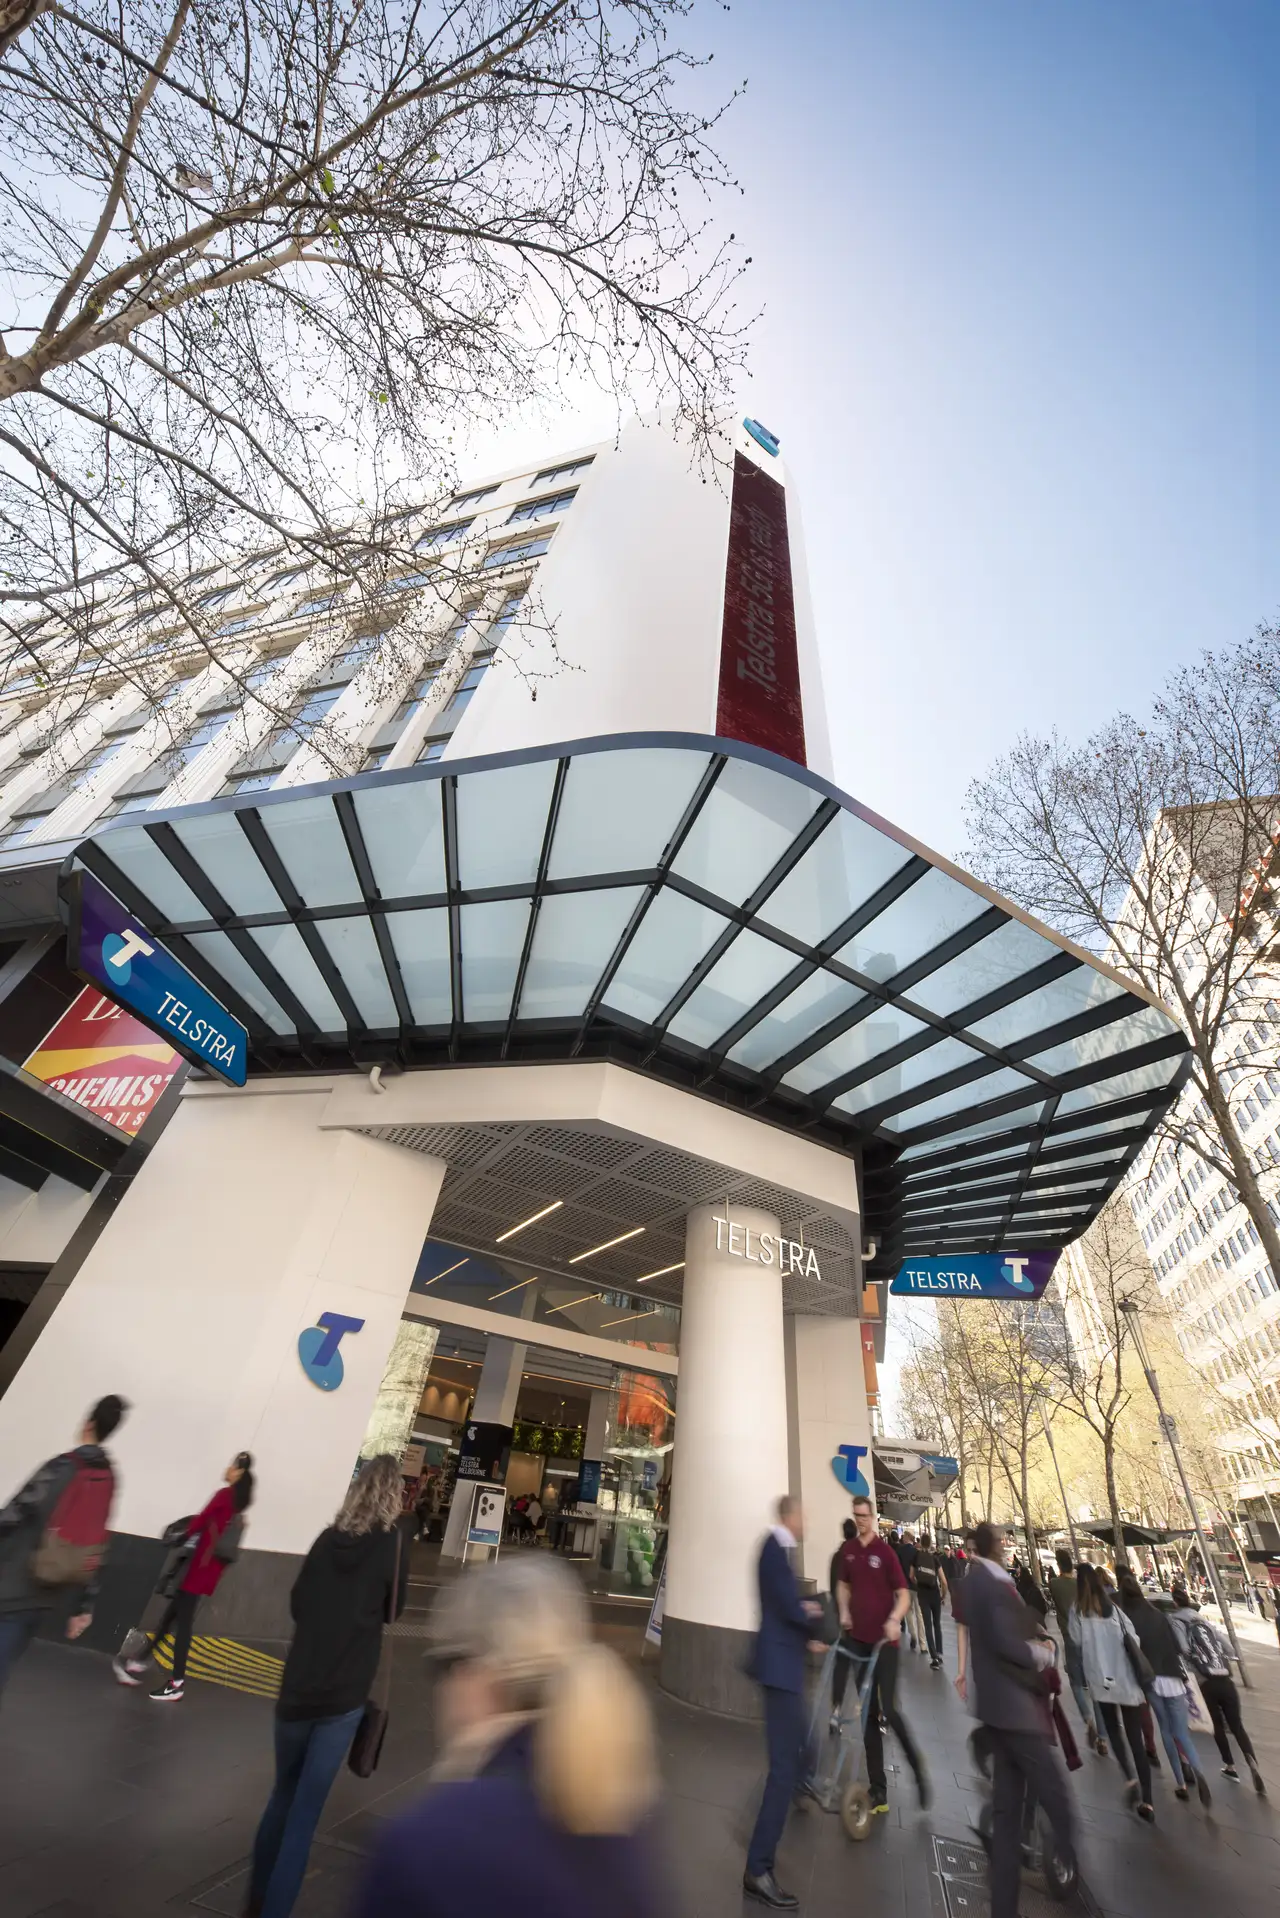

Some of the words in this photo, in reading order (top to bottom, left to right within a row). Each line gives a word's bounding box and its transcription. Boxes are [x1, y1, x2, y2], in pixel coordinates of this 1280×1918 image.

[736, 600, 777, 693] Telstra
[157, 991, 236, 1067] TELSTRA
[712, 1216, 821, 1281] TELSTRA
[906, 1271, 982, 1290] TELSTRA
[889, 1491, 909, 1503] Target
[910, 1494, 934, 1503] Centre
